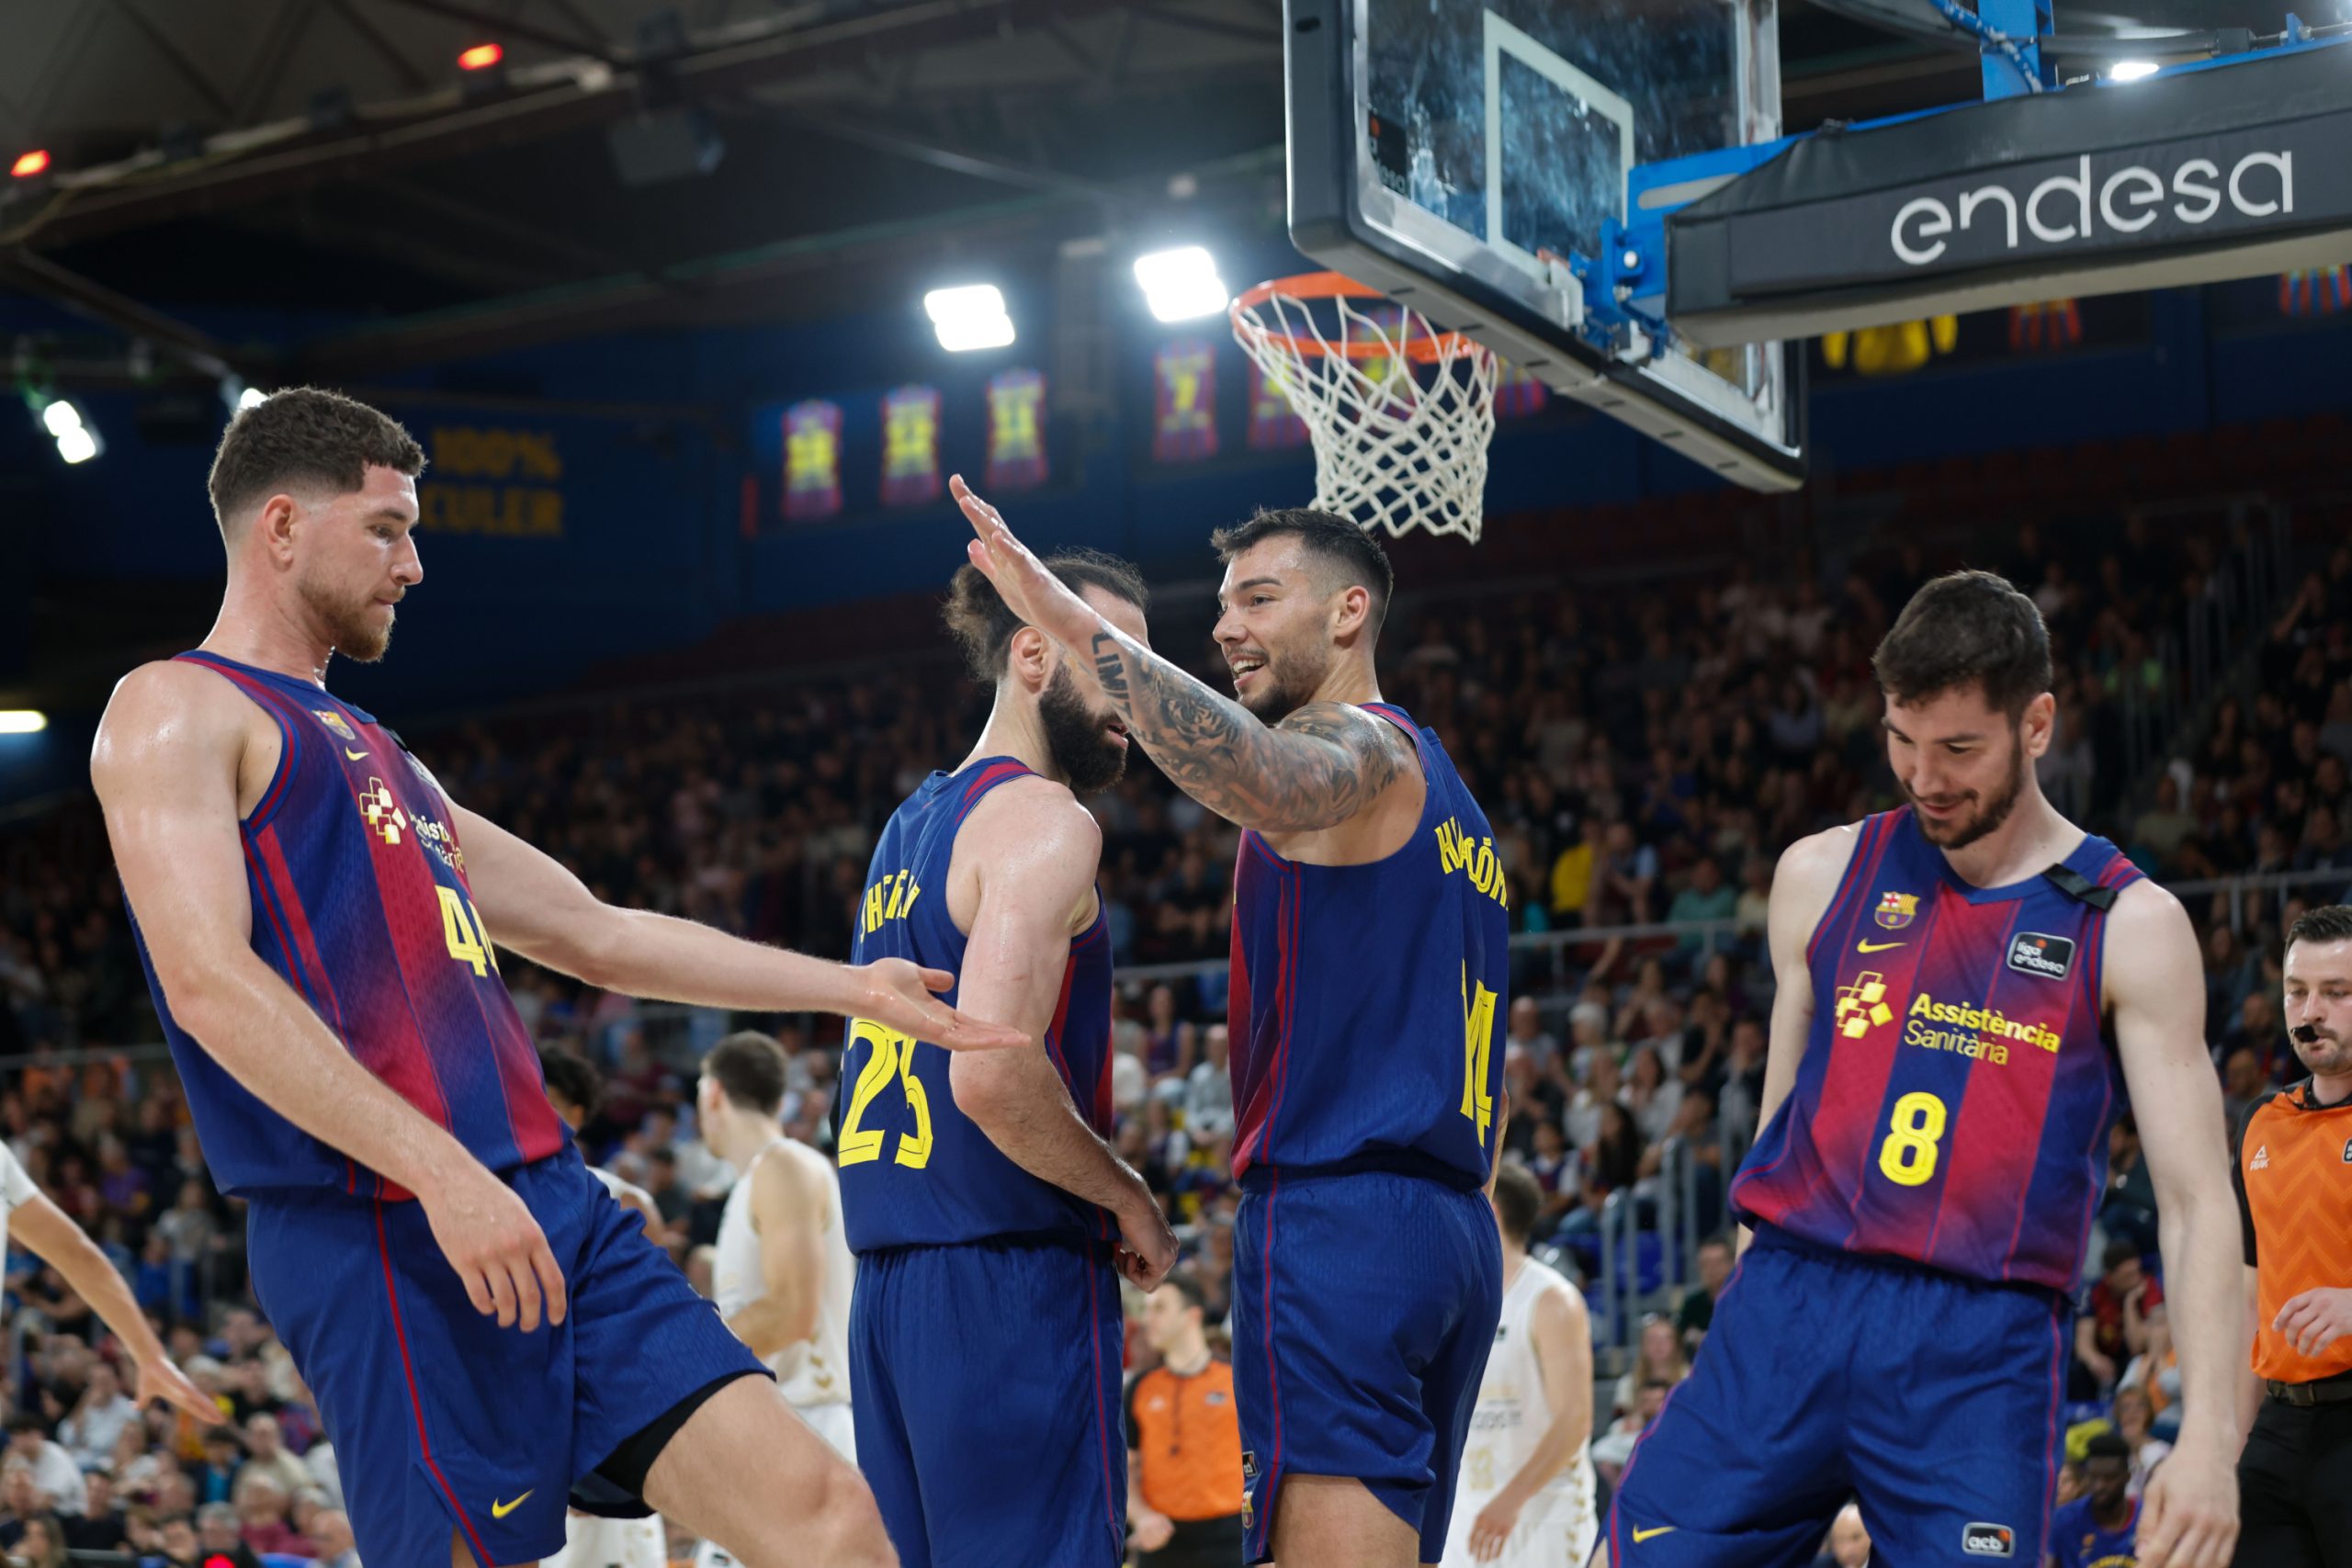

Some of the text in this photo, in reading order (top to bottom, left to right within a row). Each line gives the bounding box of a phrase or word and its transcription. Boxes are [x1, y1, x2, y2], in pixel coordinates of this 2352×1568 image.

[1891, 151, 2293, 265] endesa
[2014, 954, 2065, 974] endesa
[2017, 942, 2041, 956] liga
[1904, 1020, 2009, 1066] Sanitària
[1908, 992, 2061, 1054] Assistència
[1460, 957, 1498, 1148] 14
[1879, 1091, 1947, 1186] 8
[1968, 1535, 2004, 1551] acb
